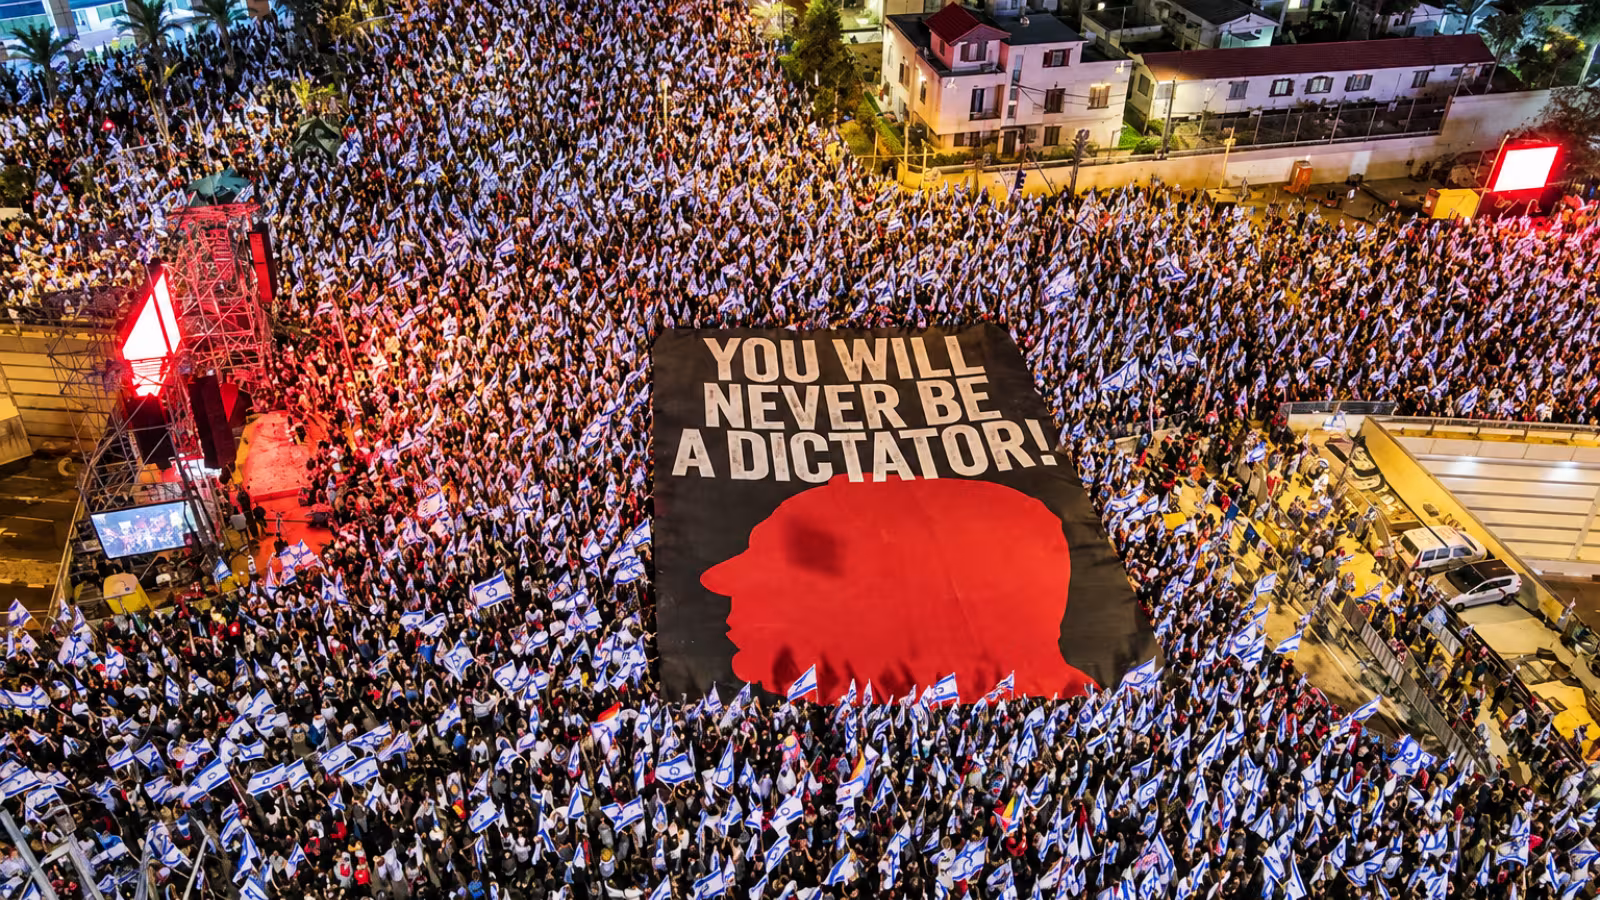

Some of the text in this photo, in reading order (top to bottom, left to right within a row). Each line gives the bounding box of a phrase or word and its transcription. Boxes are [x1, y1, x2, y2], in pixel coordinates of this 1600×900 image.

[703, 335, 985, 383] YOU WILL
[703, 374, 1003, 431] NEVER BE
[671, 418, 1058, 484] A DICTATOR!
